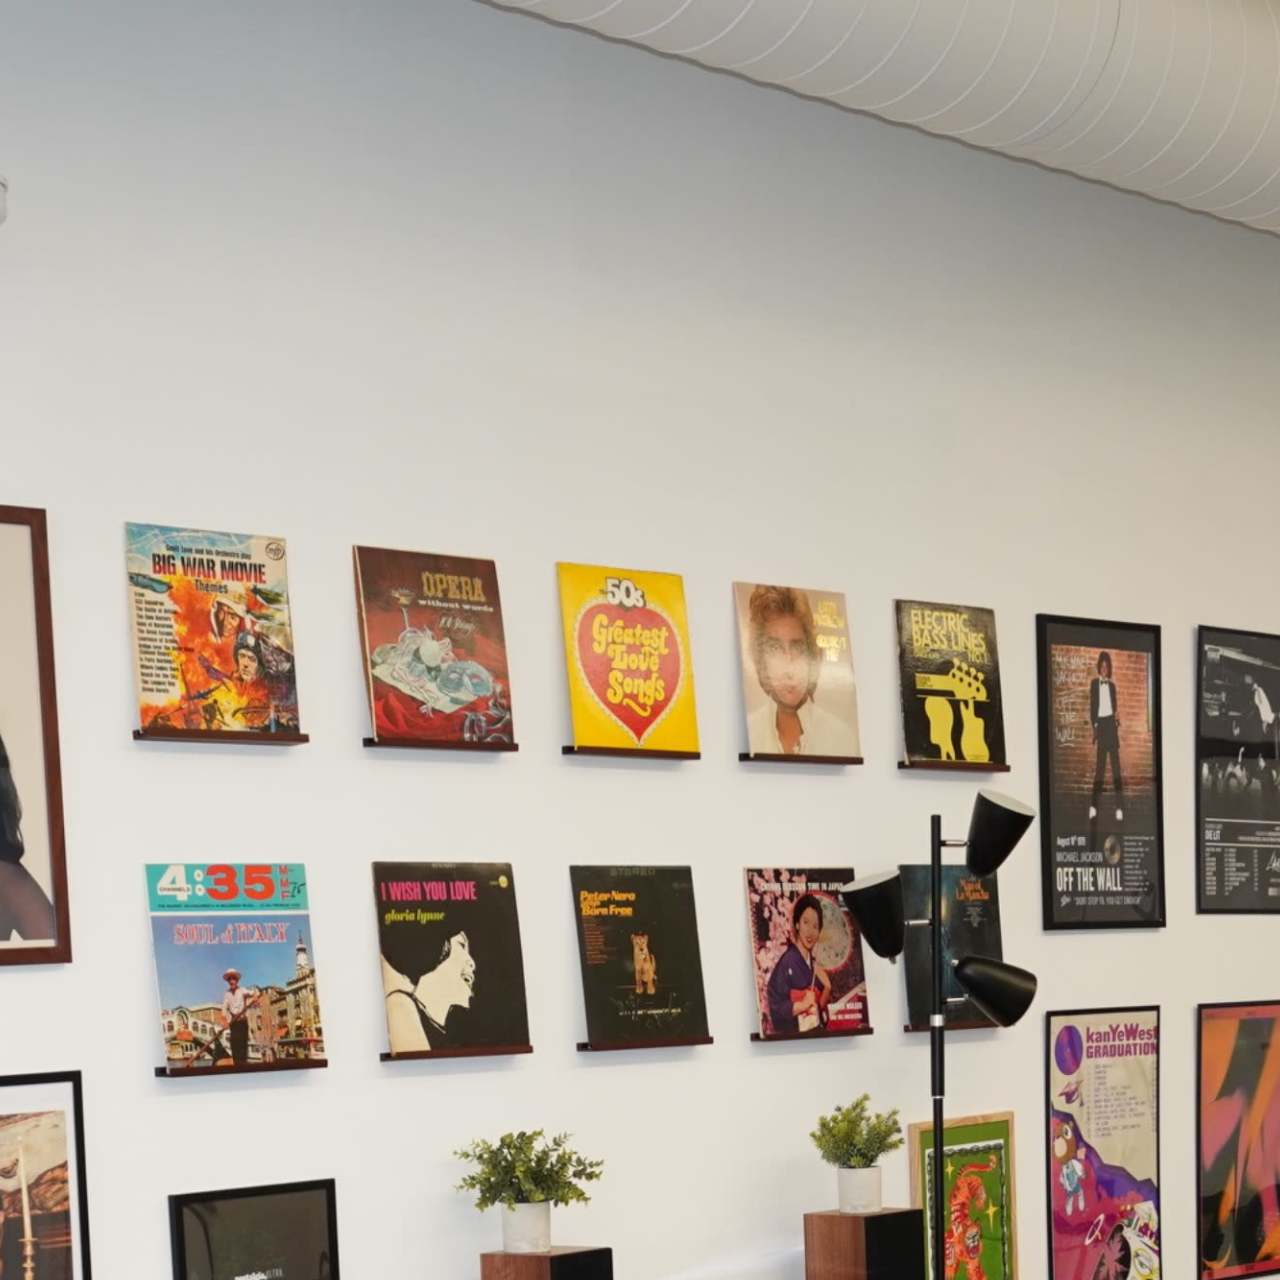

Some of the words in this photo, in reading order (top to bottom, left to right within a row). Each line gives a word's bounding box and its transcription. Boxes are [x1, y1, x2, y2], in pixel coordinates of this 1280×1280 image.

[152, 552, 177, 576] BIG
[180, 555, 216, 580] WAR
[220, 559, 267, 584] MOVIE
[195, 579, 228, 594] Themes
[421, 571, 487, 602] OPERA
[606, 576, 646, 609] 50s
[418, 599, 460, 609] without
[911, 608, 969, 633] ELECTRIC
[591, 612, 670, 656] Greatest
[912, 627, 948, 650] BASS
[950, 630, 987, 654] LINES
[607, 643, 660, 672] Love
[606, 669, 665, 708] Songs
[380, 881, 387, 901] I
[388, 881, 422, 901] WISH
[422, 881, 447, 901] YOU
[450, 881, 477, 901] LOVE
[1056, 867, 1074, 892] OFF
[1076, 867, 1095, 892] THE
[1097, 867, 1123, 892] WALL
[580, 890, 610, 901] Peter
[611, 890, 636, 901] Nero
[384, 908, 415, 925] gloria
[416, 908, 445, 924] lynne
[582, 904, 608, 916] Born
[609, 904, 633, 917] Free
[173, 923, 218, 944] SOUL
[233, 922, 290, 944] ITALY
[1086, 1042, 1158, 1059] GRADUATION
